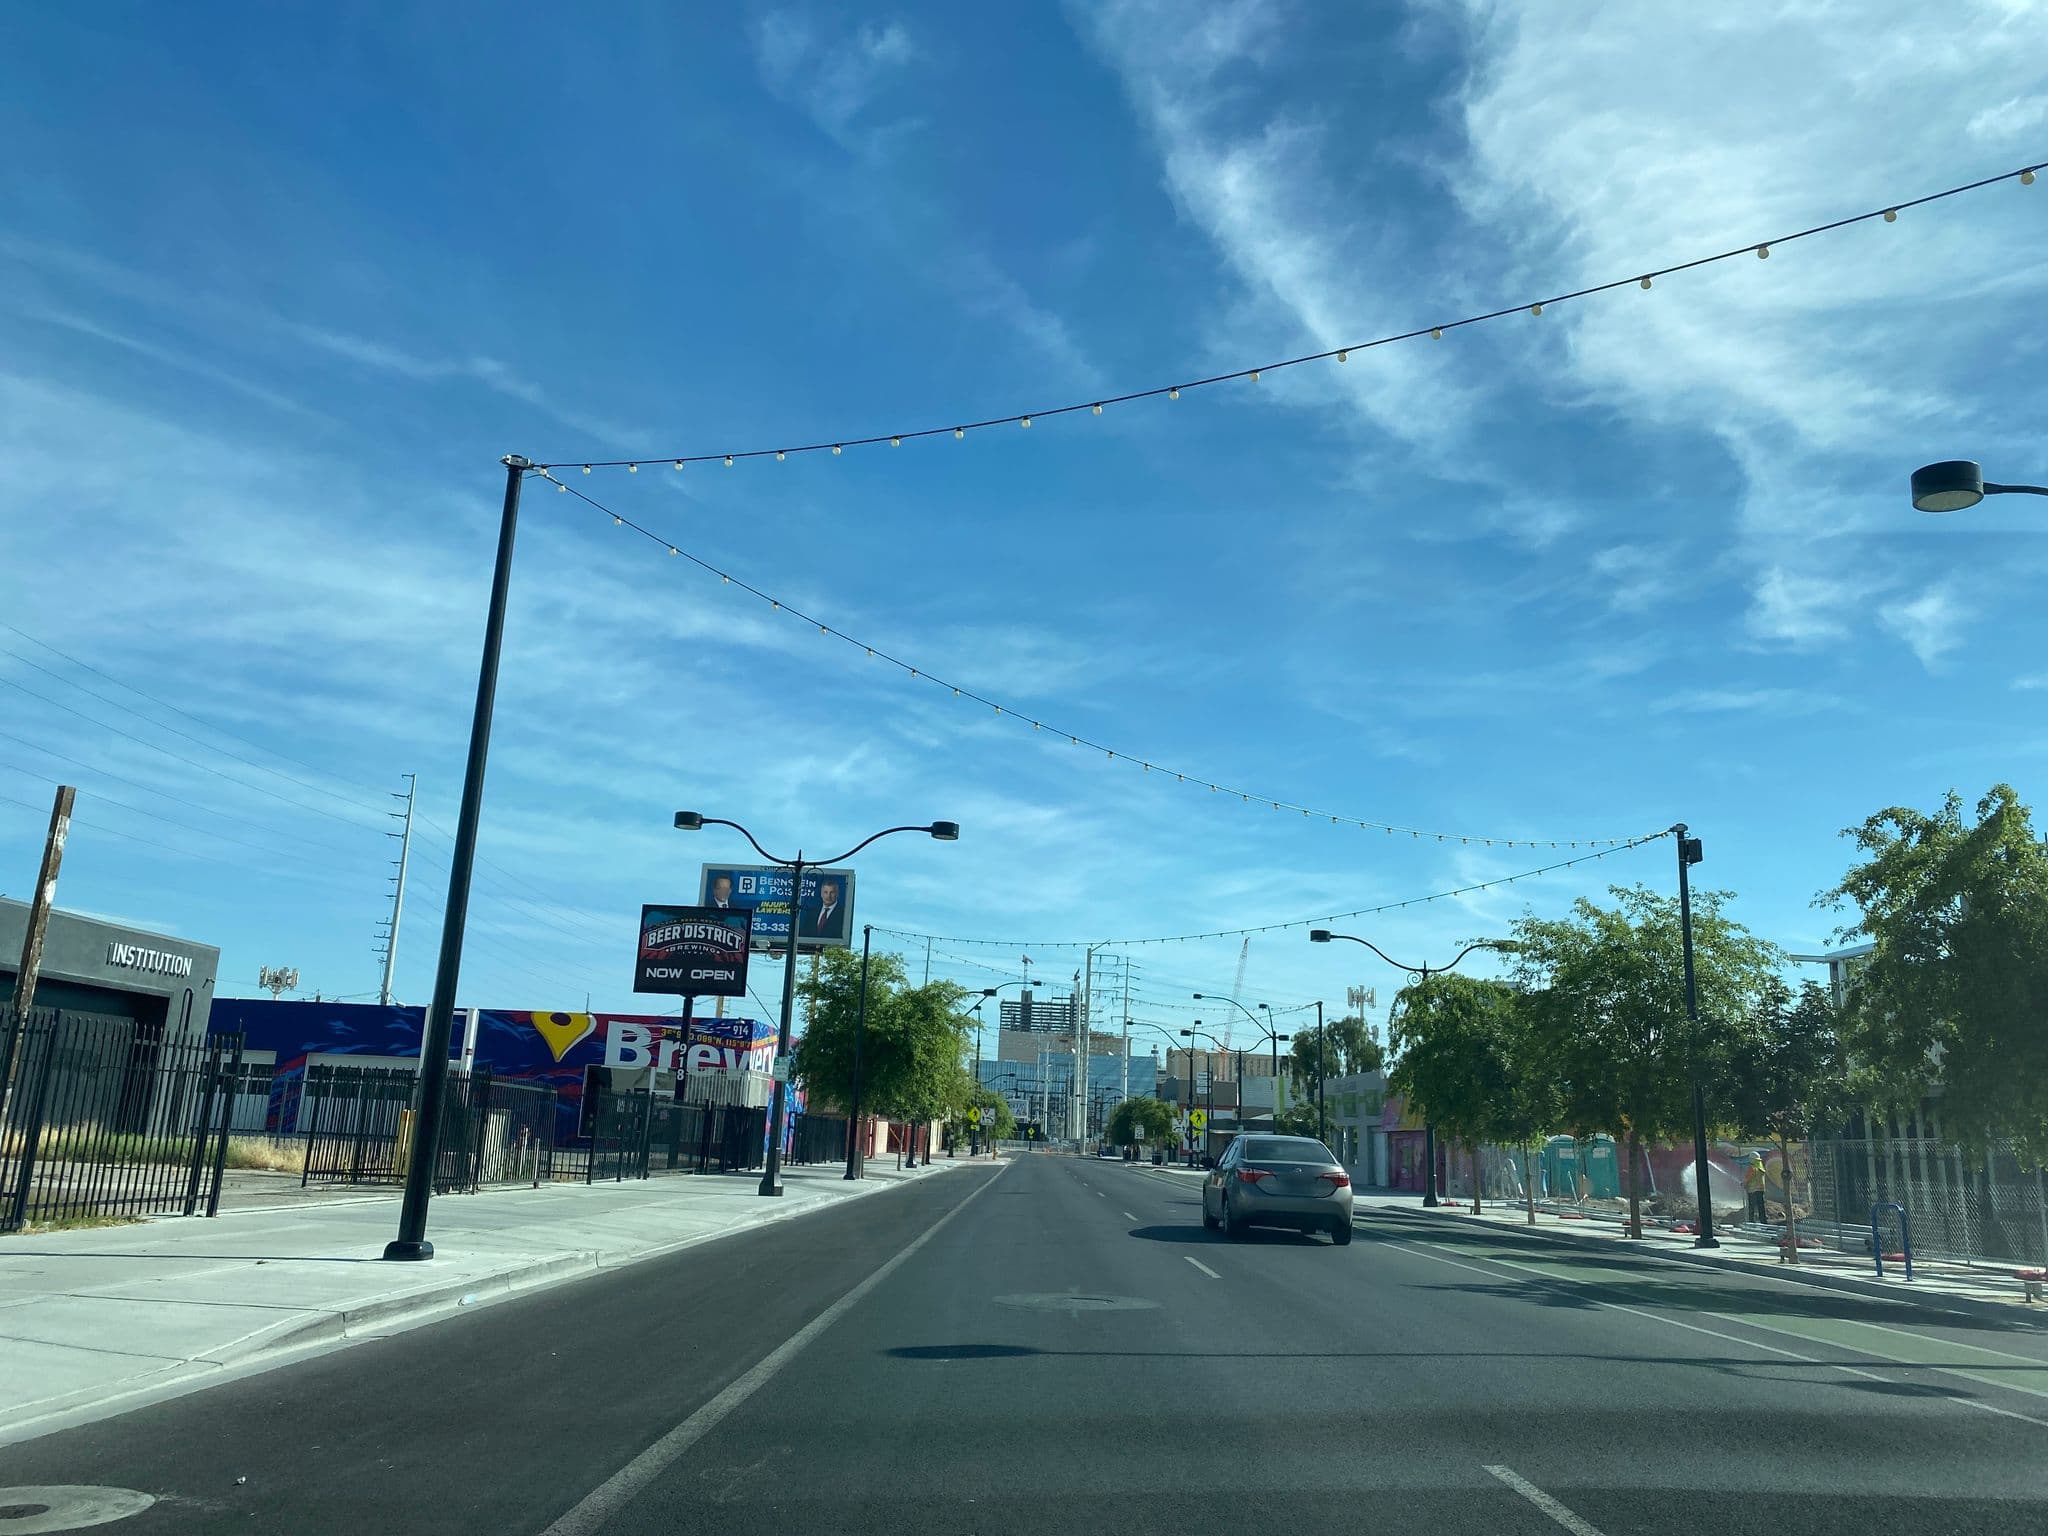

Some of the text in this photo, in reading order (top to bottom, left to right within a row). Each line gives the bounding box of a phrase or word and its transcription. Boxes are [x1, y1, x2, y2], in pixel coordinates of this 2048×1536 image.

[759, 876, 816, 888] BERNSEIN
[769, 886, 815, 897] POISON
[648, 926, 681, 947] BEER
[683, 924, 742, 949] DISTRICT
[670, 945, 716, 953] BREWING
[112, 942, 193, 976] INSTITUTION
[646, 968, 735, 981] NOW OPEN
[733, 1025, 749, 1035] 914
[677, 1043, 688, 1081] 918
